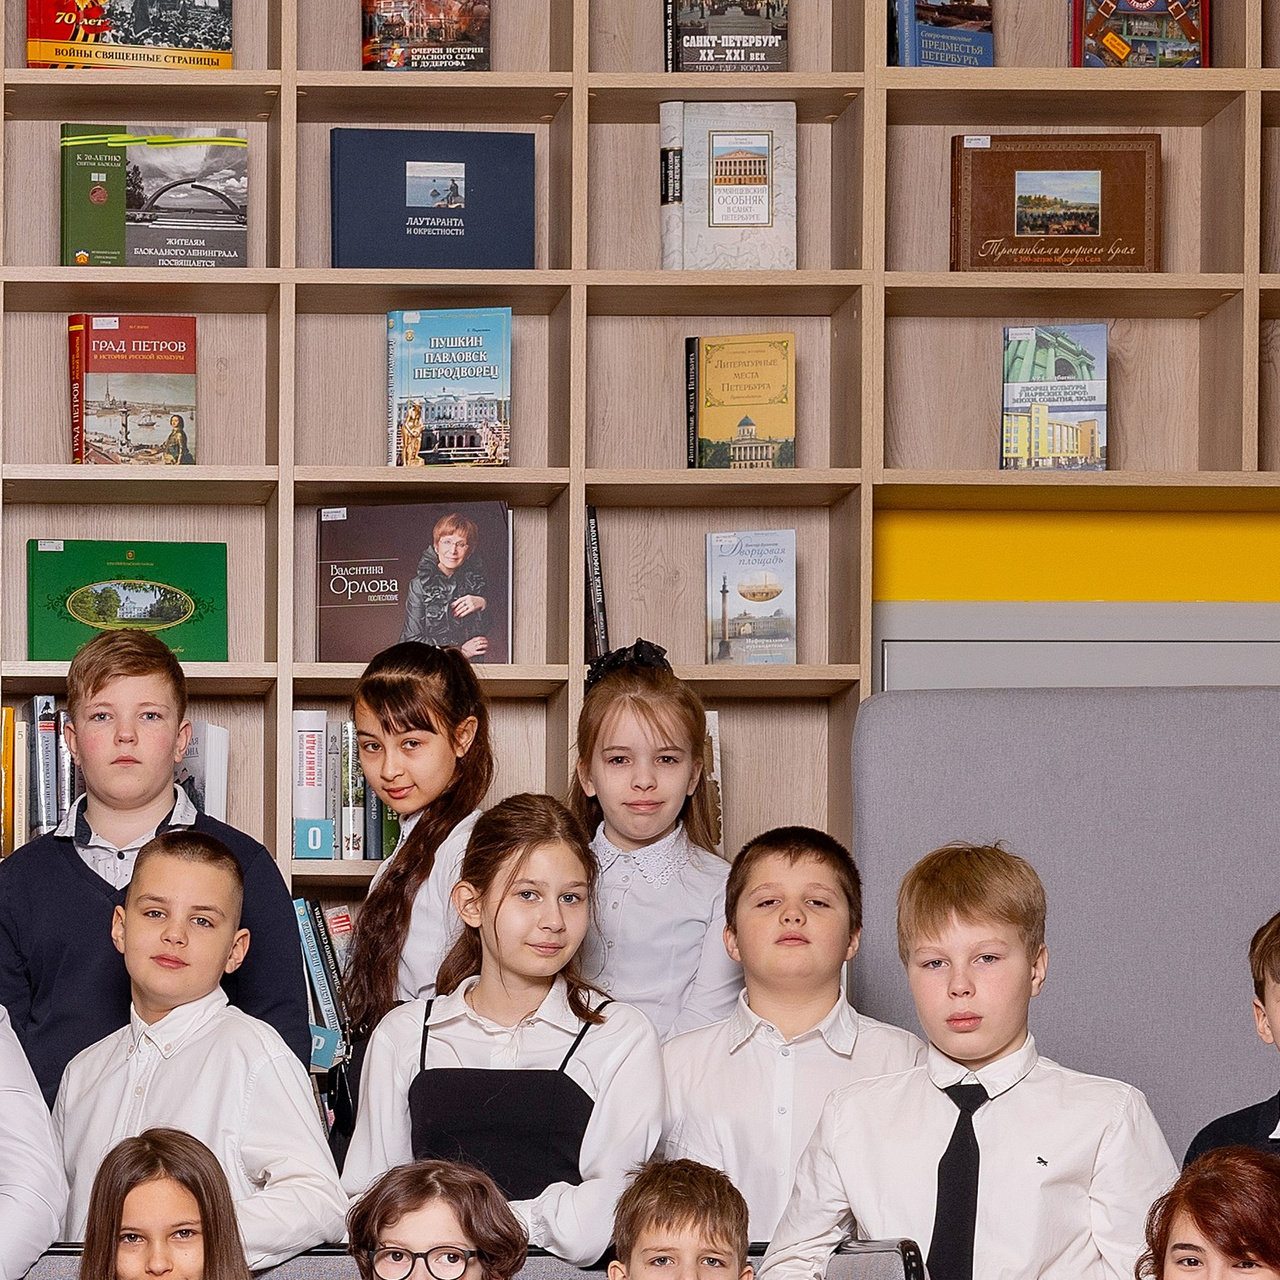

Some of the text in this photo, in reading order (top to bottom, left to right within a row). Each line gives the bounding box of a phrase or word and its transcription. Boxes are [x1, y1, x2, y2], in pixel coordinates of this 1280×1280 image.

[55, 11, 105, 27] 70 лет
[682, 35, 782, 48] САНКТ-ПЕТЕРБУРГ
[921, 39, 983, 55] ПРЕДМЕСТЬЯ
[54, 47, 220, 67] ВОЙНЫ СВЯЩЕННЫЕ СТРАНИЦЫ
[921, 50, 979, 66] ПЕТЕРБУРГА
[715, 186, 767, 195] РУМЯНЦЕВСКИЙ
[718, 195, 765, 206] ОСОБНЯК
[406, 217, 464, 227] ЛАУТАРАНТА
[406, 227, 465, 236] И ОКРЕСТНОСТИ
[166, 238, 205, 247] ЖИТЕЛЯМ
[134, 247, 238, 258] БЛОКАДНОГО ЛЕНИНГРАДА
[978, 237, 1137, 266] Тропинками родного края
[158, 258, 216, 267] ПОСВЯЩАЕТСЯ
[92, 340, 187, 353] ГРАД ПЕТРОВ
[430, 336, 484, 349] ПУШКИН
[424, 351, 488, 364] ПАВЛОВСК
[413, 365, 500, 380] ПЕТРОДВОРЕЦ
[72, 382, 80, 423] ПЕТРОВ
[718, 536, 786, 558] Дворцовая
[589, 518, 603, 603] МЯТЕЖ РЕФОРМАТОРОВ
[738, 555, 784, 566] площадь
[330, 564, 384, 576] Валентина
[330, 575, 399, 600] Орлова
[17, 730, 24, 740] 5
[306, 733, 316, 787] ЛЕНИНГРАДА
[371, 811, 377, 820] ОТ
[314, 906, 330, 944] СЕМЕЙСТВА
[323, 942, 336, 971] ОДНОГО
